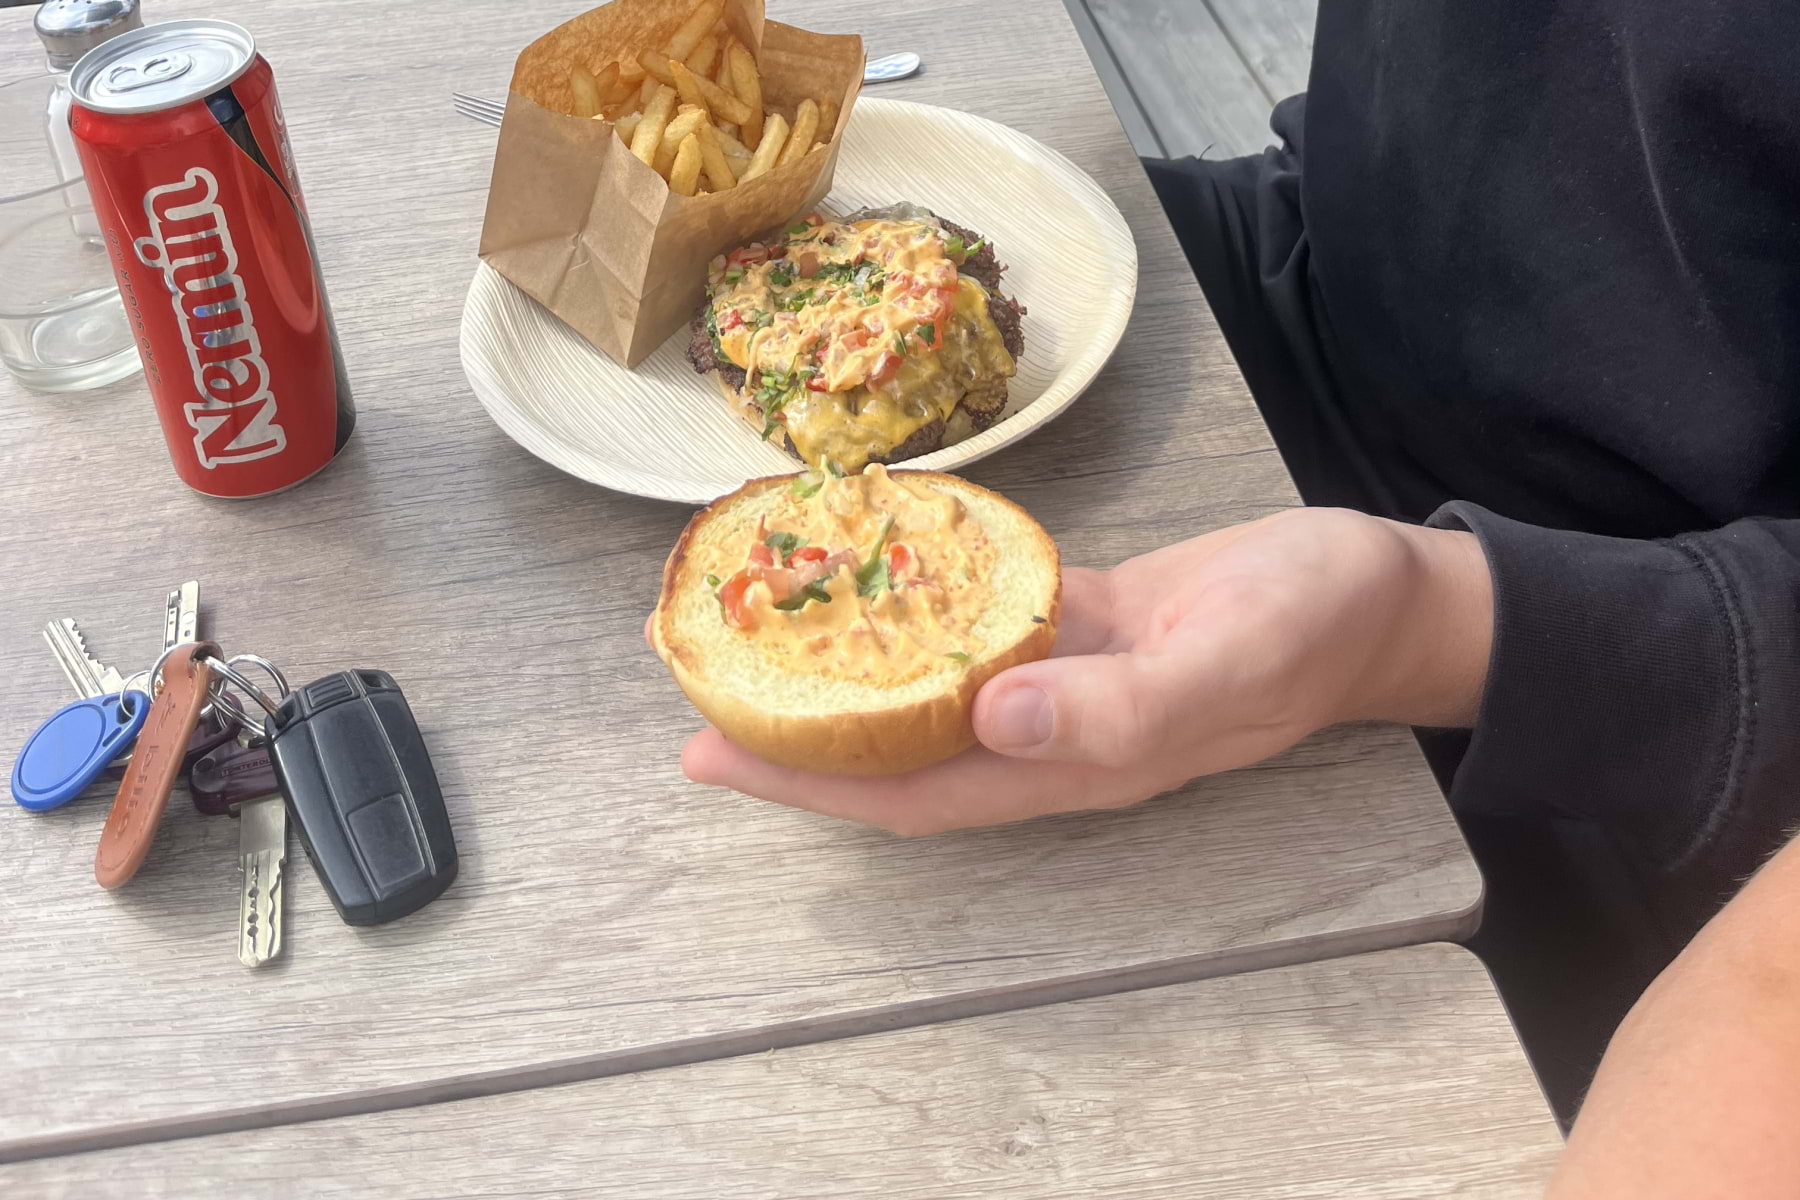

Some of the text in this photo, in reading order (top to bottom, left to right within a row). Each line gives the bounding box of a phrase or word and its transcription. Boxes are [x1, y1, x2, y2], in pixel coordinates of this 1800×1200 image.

[121, 269, 161, 385] ZERO SUGAR
[134, 167, 286, 469] Nermin
